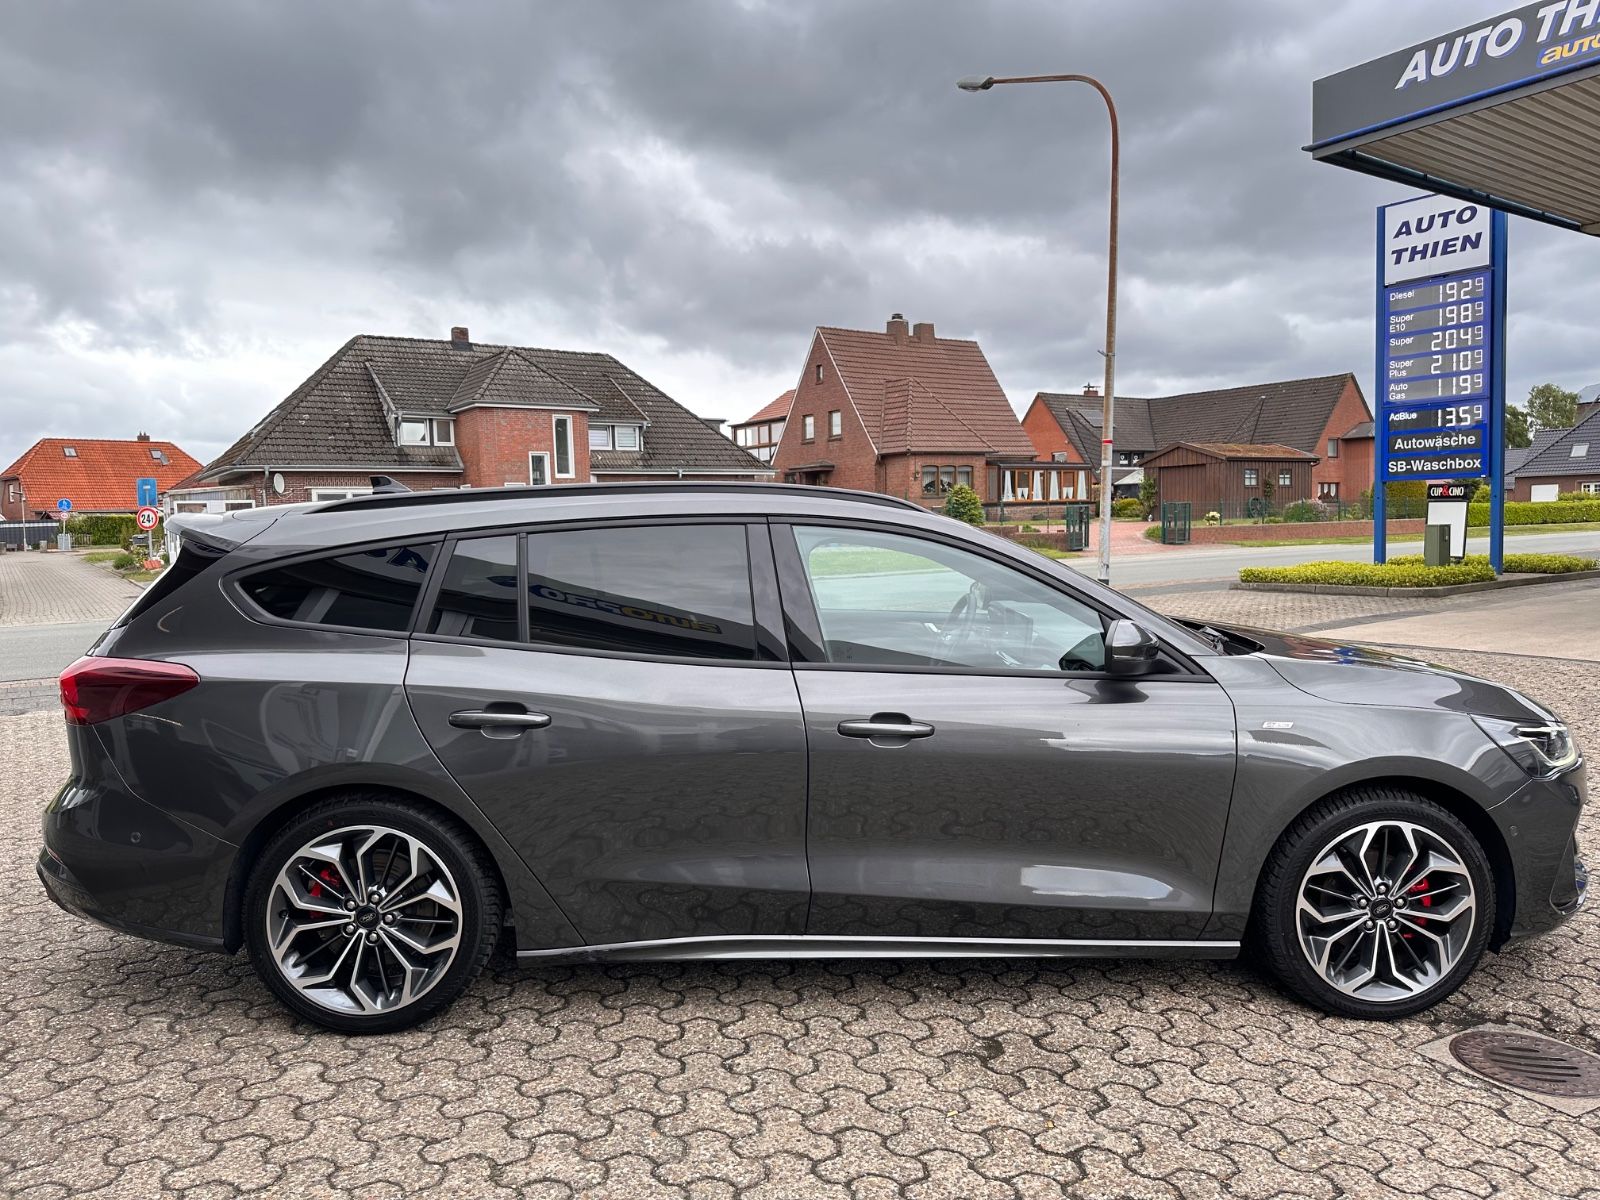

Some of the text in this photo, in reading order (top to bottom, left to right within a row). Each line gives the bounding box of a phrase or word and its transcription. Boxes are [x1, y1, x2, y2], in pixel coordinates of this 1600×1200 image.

[1395, 0, 1600, 90] AUTO TH
[1393, 205, 1478, 239] AUTO
[1391, 232, 1483, 265] THIEN
[1389, 290, 1415, 301] Diesel
[1390, 314, 1415, 325] Super
[1389, 324, 1406, 333] E10
[1389, 337, 1414, 347] Super
[1389, 360, 1414, 370] Super
[1389, 369, 1407, 378] Plus
[1389, 383, 1409, 392] Auto
[1389, 392, 1406, 400] Gas
[1389, 411, 1418, 421] AdBlue
[1394, 434, 1476, 450] Autowäsche
[1388, 458, 1482, 473] SB-Waschbox
